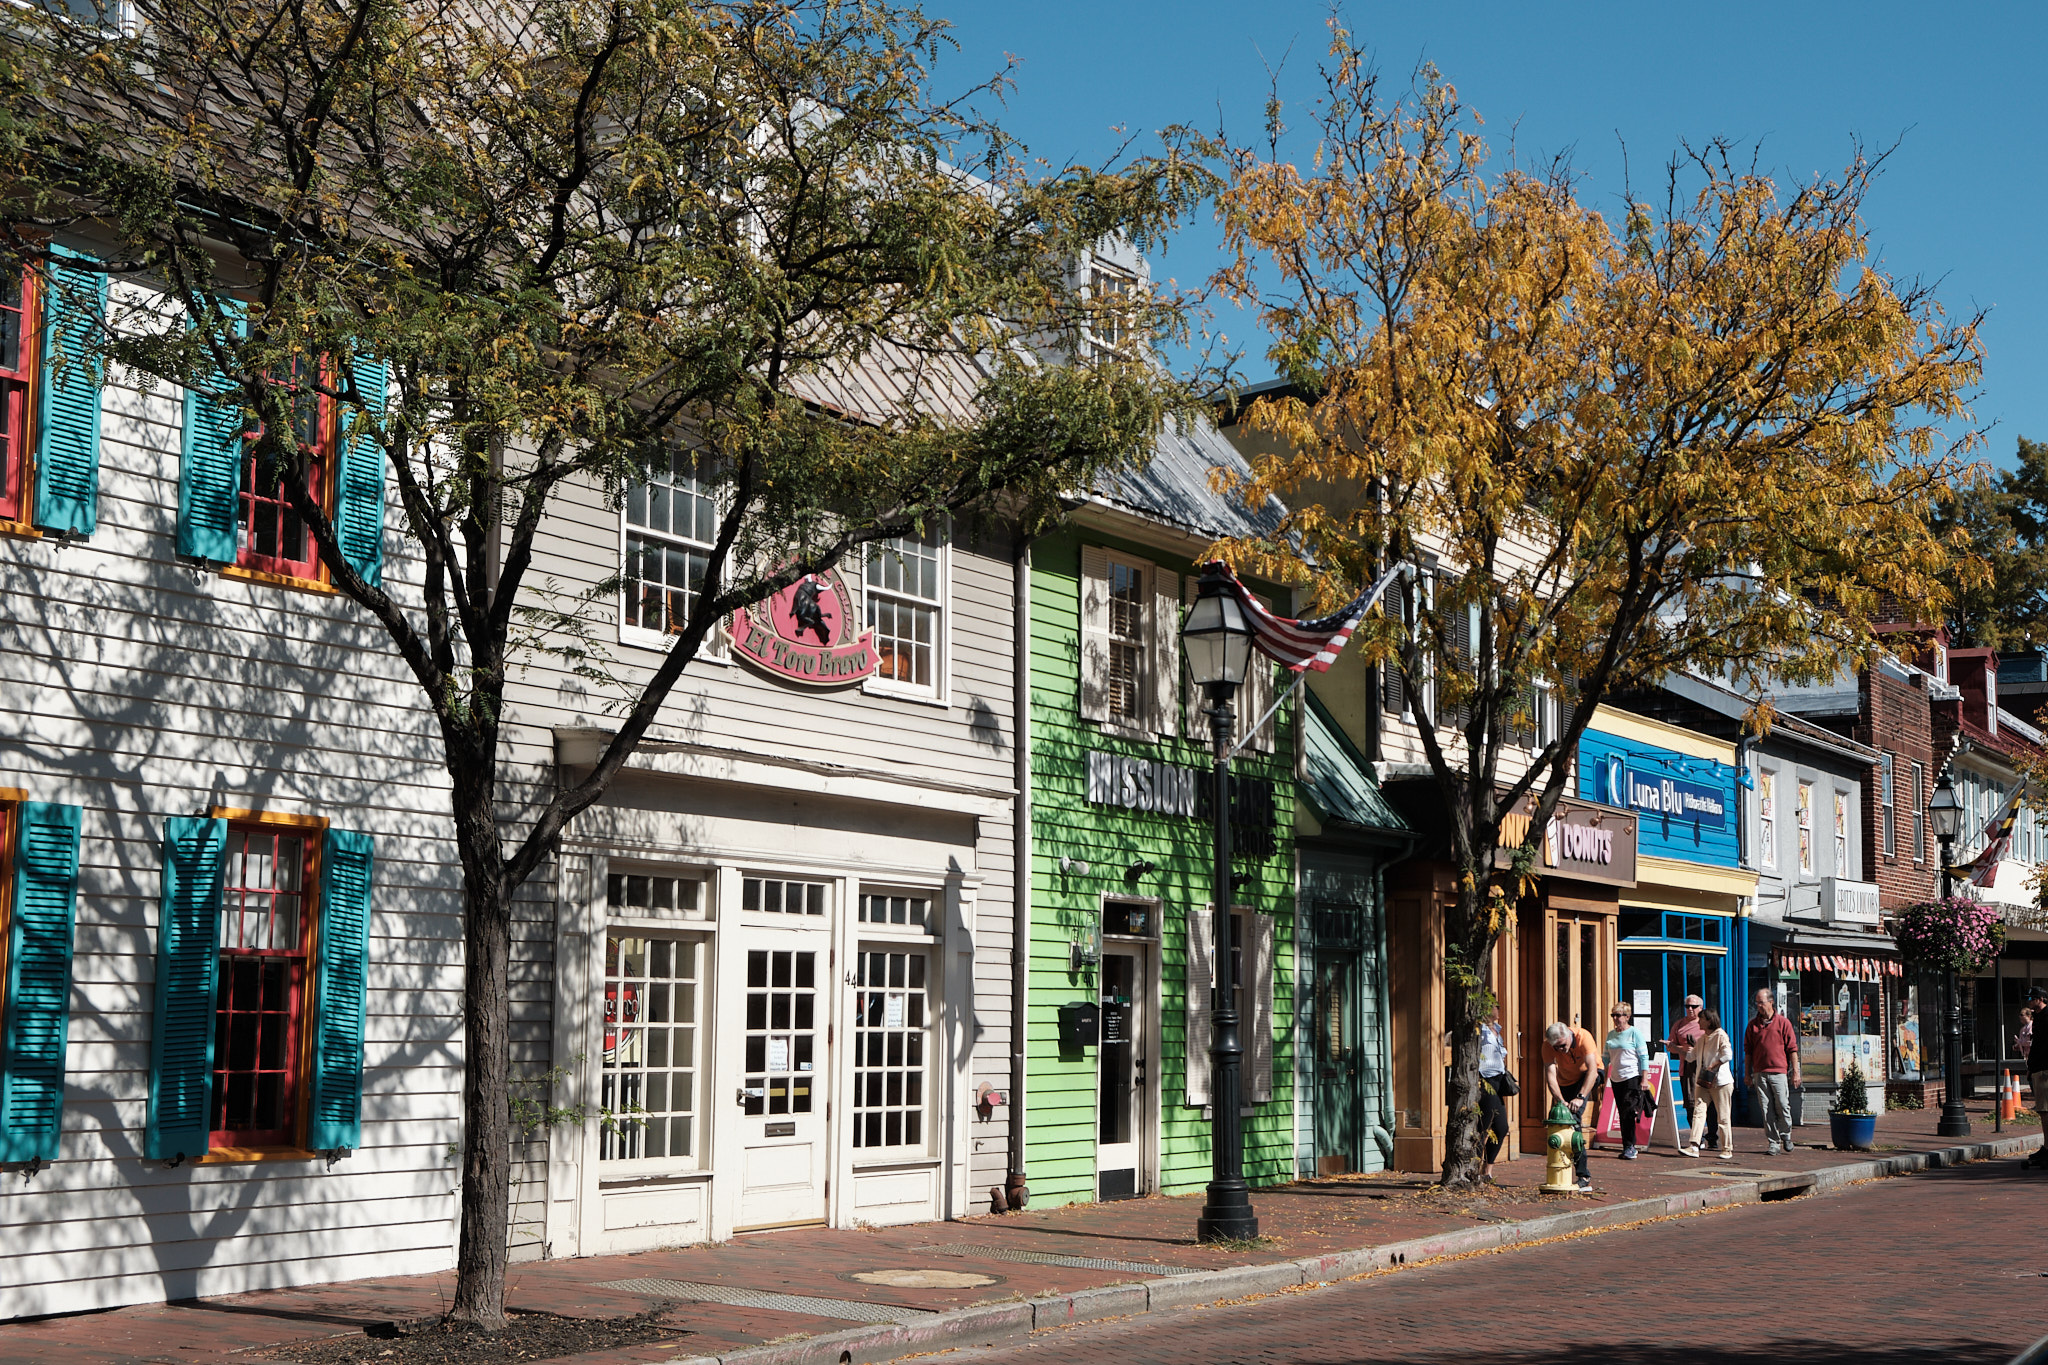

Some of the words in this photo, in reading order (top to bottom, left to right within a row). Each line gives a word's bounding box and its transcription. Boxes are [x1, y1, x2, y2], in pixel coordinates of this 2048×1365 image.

[744, 627, 772, 659] El
[773, 642, 817, 674] Toro
[818, 650, 868, 676] Bravo
[1086, 751, 1195, 817] MISSION
[1628, 772, 1660, 811] Luna
[1660, 779, 1683, 815] Blu
[1562, 824, 1612, 864] DONUTS
[1857, 890, 1878, 915] LIQUORS
[845, 969, 857, 989] 44
[1083, 973, 1094, 987] 40
